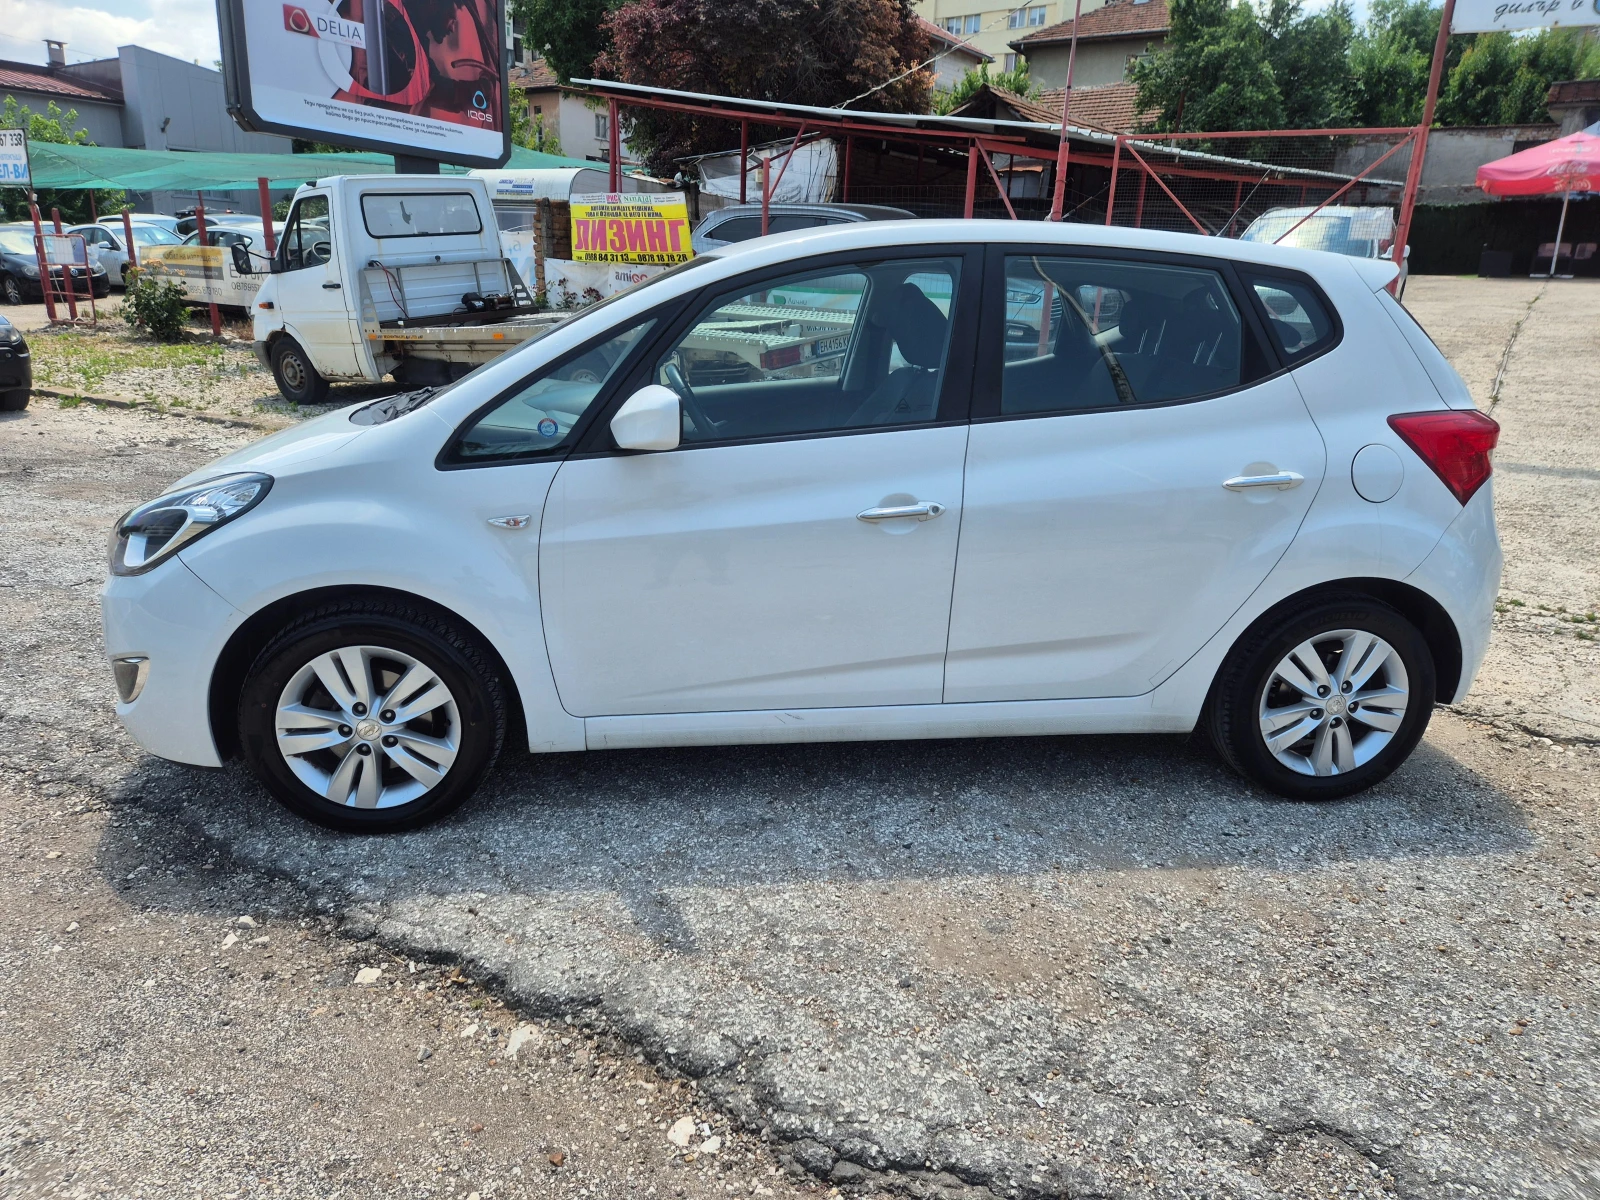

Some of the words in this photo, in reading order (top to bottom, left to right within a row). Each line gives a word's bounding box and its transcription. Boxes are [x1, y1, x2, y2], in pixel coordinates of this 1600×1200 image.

[317, 17, 362, 41] DELIA
[467, 109, 493, 122] IQOS
[574, 218, 685, 252] ЛИЗИНГ
[610, 253, 619, 262] 31
[619, 253, 630, 262] 13
[828, 337, 843, 351] 4156
